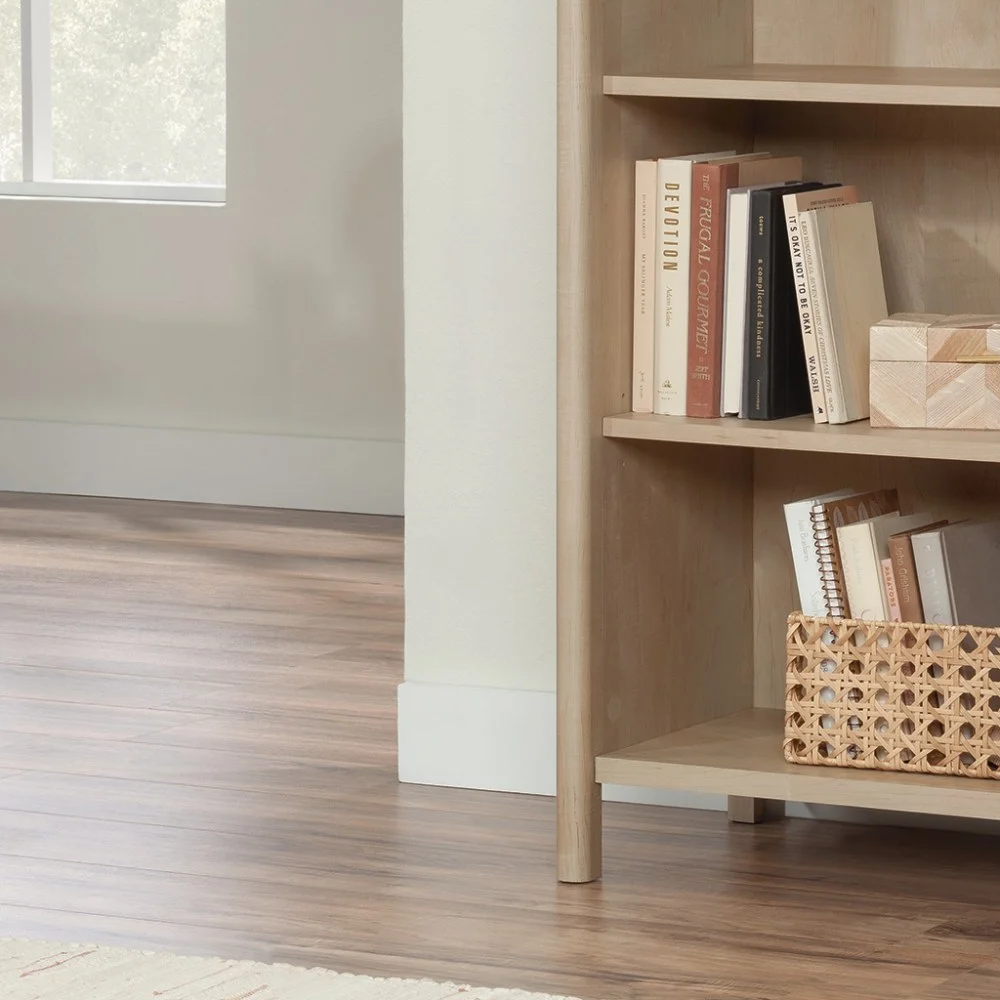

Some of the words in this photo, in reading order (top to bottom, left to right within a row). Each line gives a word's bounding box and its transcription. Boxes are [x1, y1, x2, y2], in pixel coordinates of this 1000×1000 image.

[702, 174, 710, 191] THE
[663, 183, 680, 271] DEVOTION
[698, 197, 712, 265] FRUGAL
[791, 235, 802, 258] OKAY
[795, 261, 804, 279] NOT
[756, 266, 764, 318] complicated
[798, 282, 806, 294] TO
[696, 268, 710, 355] GOURMET
[800, 298, 808, 309] BE
[802, 312, 812, 335] OKAY
[756, 320, 764, 358] kindness
[808, 355, 820, 393] WALSH
[895, 546, 904, 567] John
